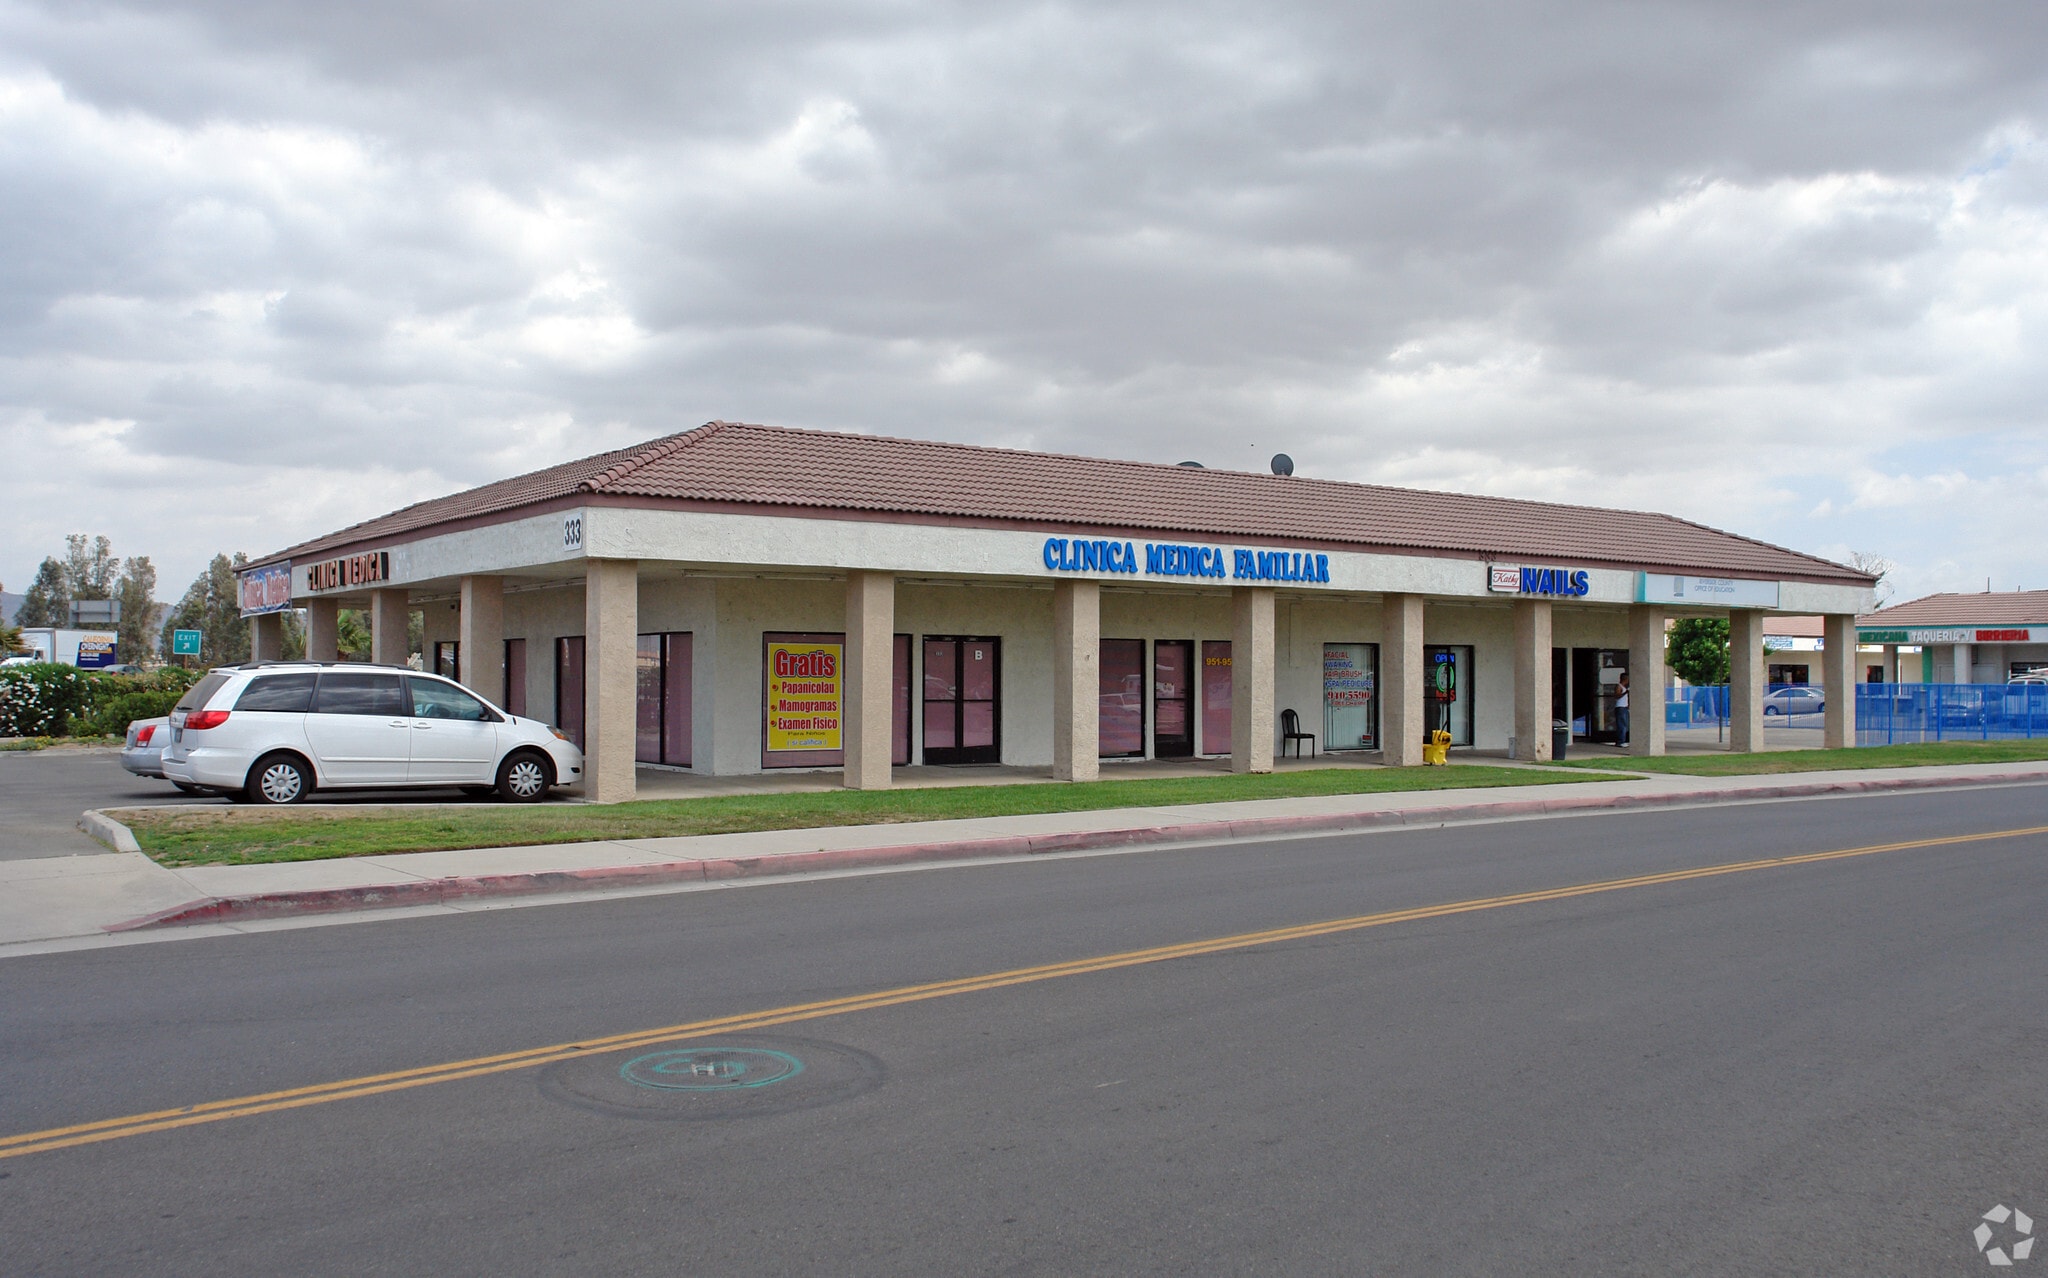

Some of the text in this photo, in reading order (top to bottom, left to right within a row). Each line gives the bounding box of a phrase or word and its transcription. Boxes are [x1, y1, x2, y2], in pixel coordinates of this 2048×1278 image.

[565, 519, 581, 545] 333
[1043, 537, 1330, 583] CLINICA MEDICA FAMILIAR
[307, 552, 388, 591] CLINICA MEDICA
[1493, 568, 1589, 597] Kathy NAILS
[1912, 630, 1959, 643] TAQUERIA
[774, 649, 836, 679] Gratis
[974, 649, 983, 660] B
[781, 681, 835, 695] Papanicolau
[779, 699, 837, 713] Mamogramas
[778, 717, 811, 730] Examen
